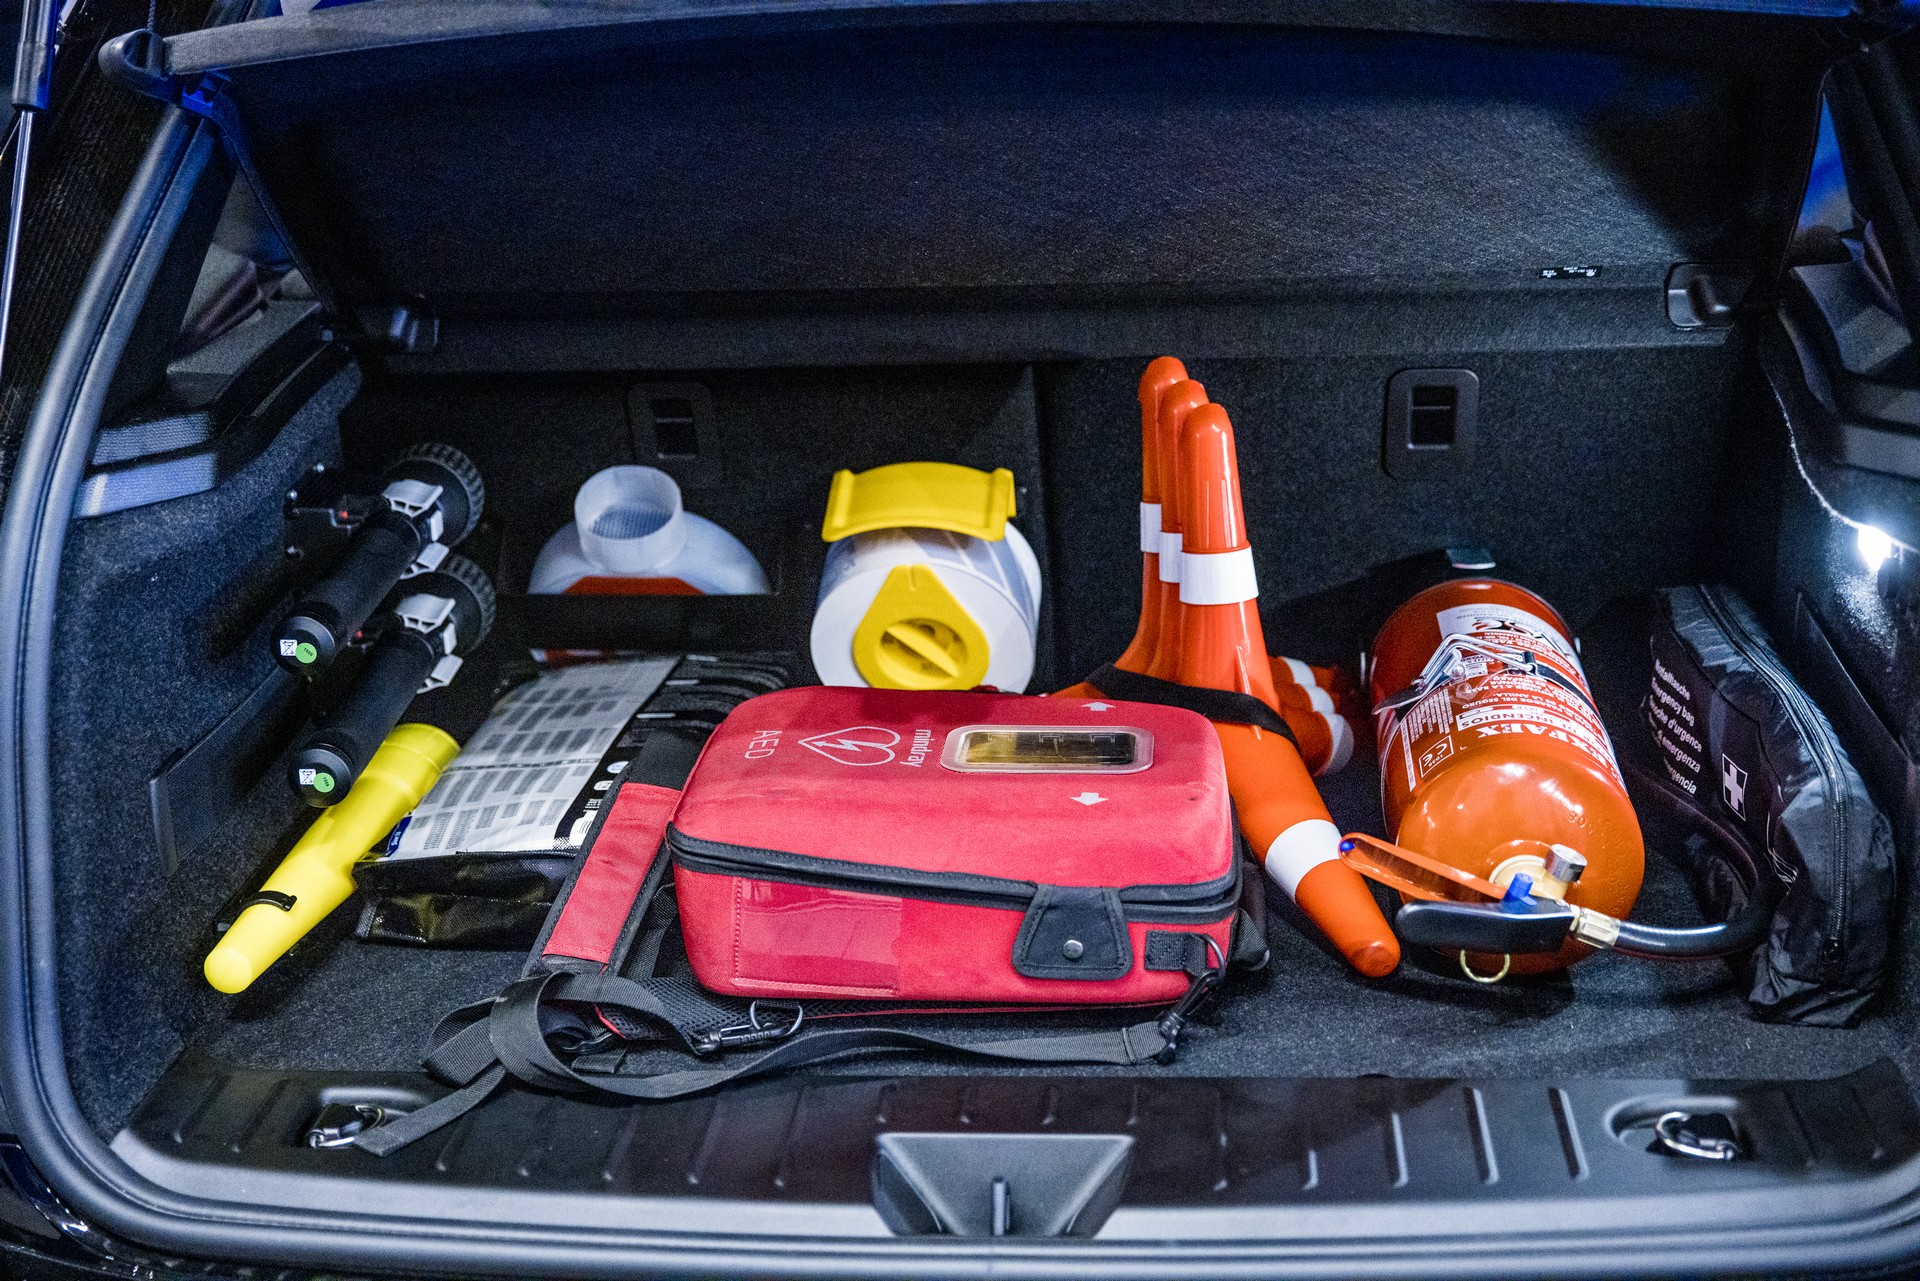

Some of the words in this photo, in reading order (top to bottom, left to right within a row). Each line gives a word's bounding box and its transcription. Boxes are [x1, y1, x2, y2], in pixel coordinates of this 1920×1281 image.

[1461, 697, 1499, 709] SEGURO
[1681, 706, 1695, 727] bag
[1461, 713, 1554, 728] INCENDIOS
[1667, 718, 1702, 752] d'urgence
[744, 729, 783, 760] AED
[900, 728, 932, 768] mindray
[1475, 723, 1608, 767] EXFAEX
[1661, 736, 1701, 773] emergenza
